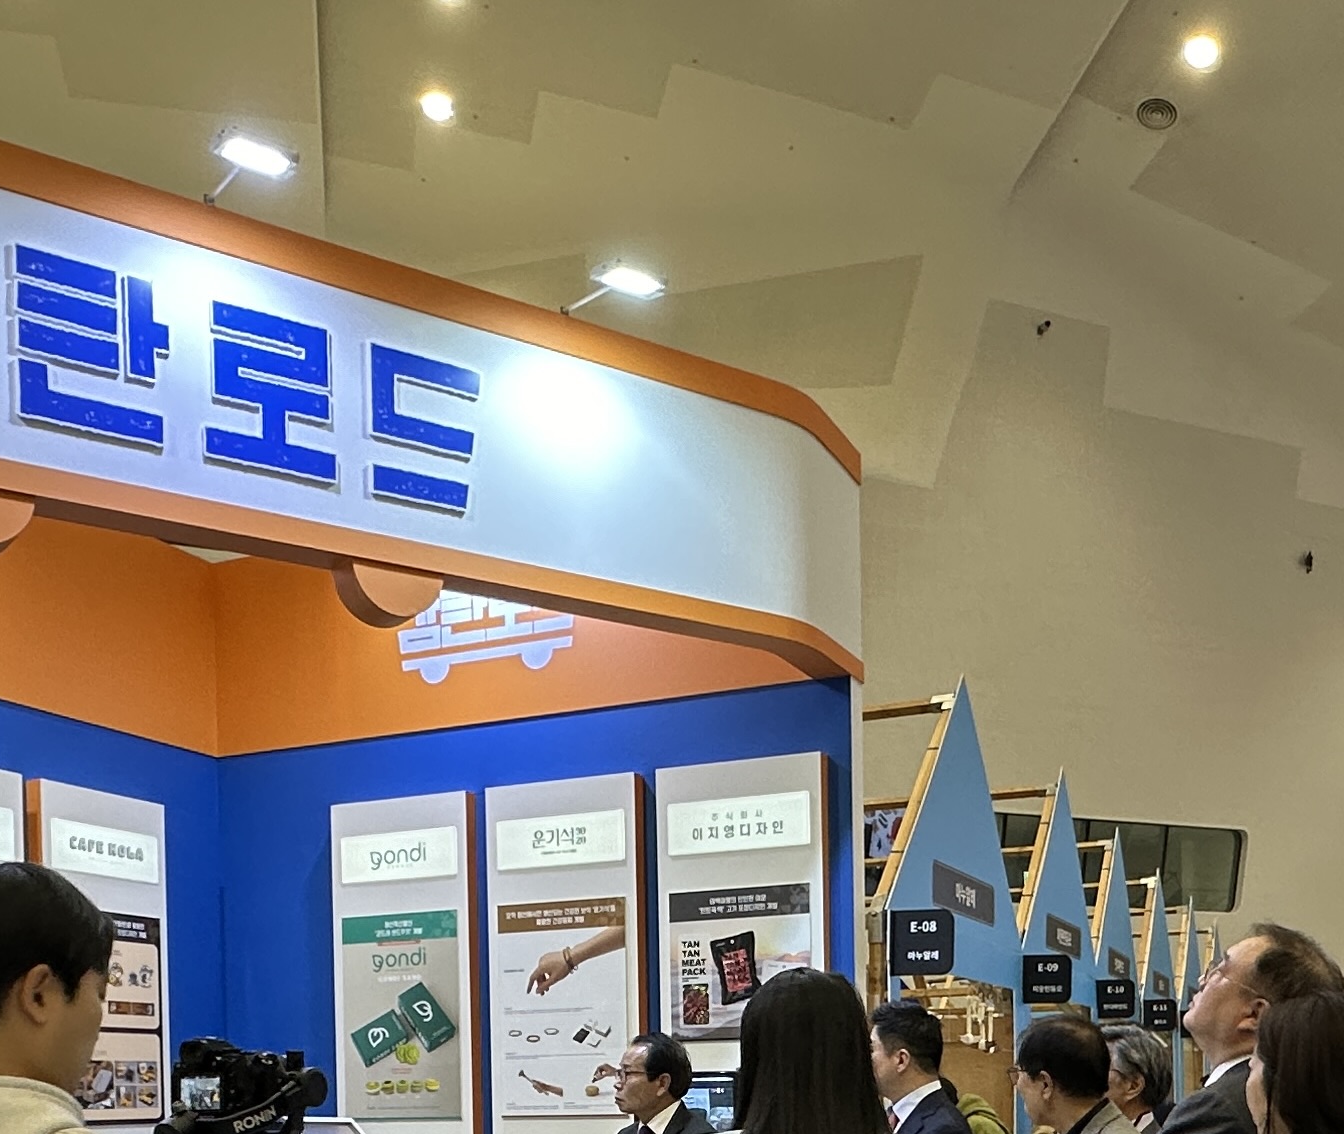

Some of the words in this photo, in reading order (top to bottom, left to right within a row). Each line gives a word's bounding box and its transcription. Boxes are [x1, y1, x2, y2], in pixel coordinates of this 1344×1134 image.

[532, 826, 574, 849] 운기석
[692, 820, 784, 841] 이지영디자인
[69, 836, 103, 855] CAFE
[369, 841, 427, 871] gondi
[910, 920, 937, 933] E-08
[681, 940, 700, 948] TAN
[372, 946, 427, 973] gondi
[681, 958, 707, 967] MEAT
[1037, 962, 1059, 973] E-09
[681, 967, 707, 976] PACK
[1107, 985, 1125, 994] E-10
[232, 1104, 277, 1134] RONIN
